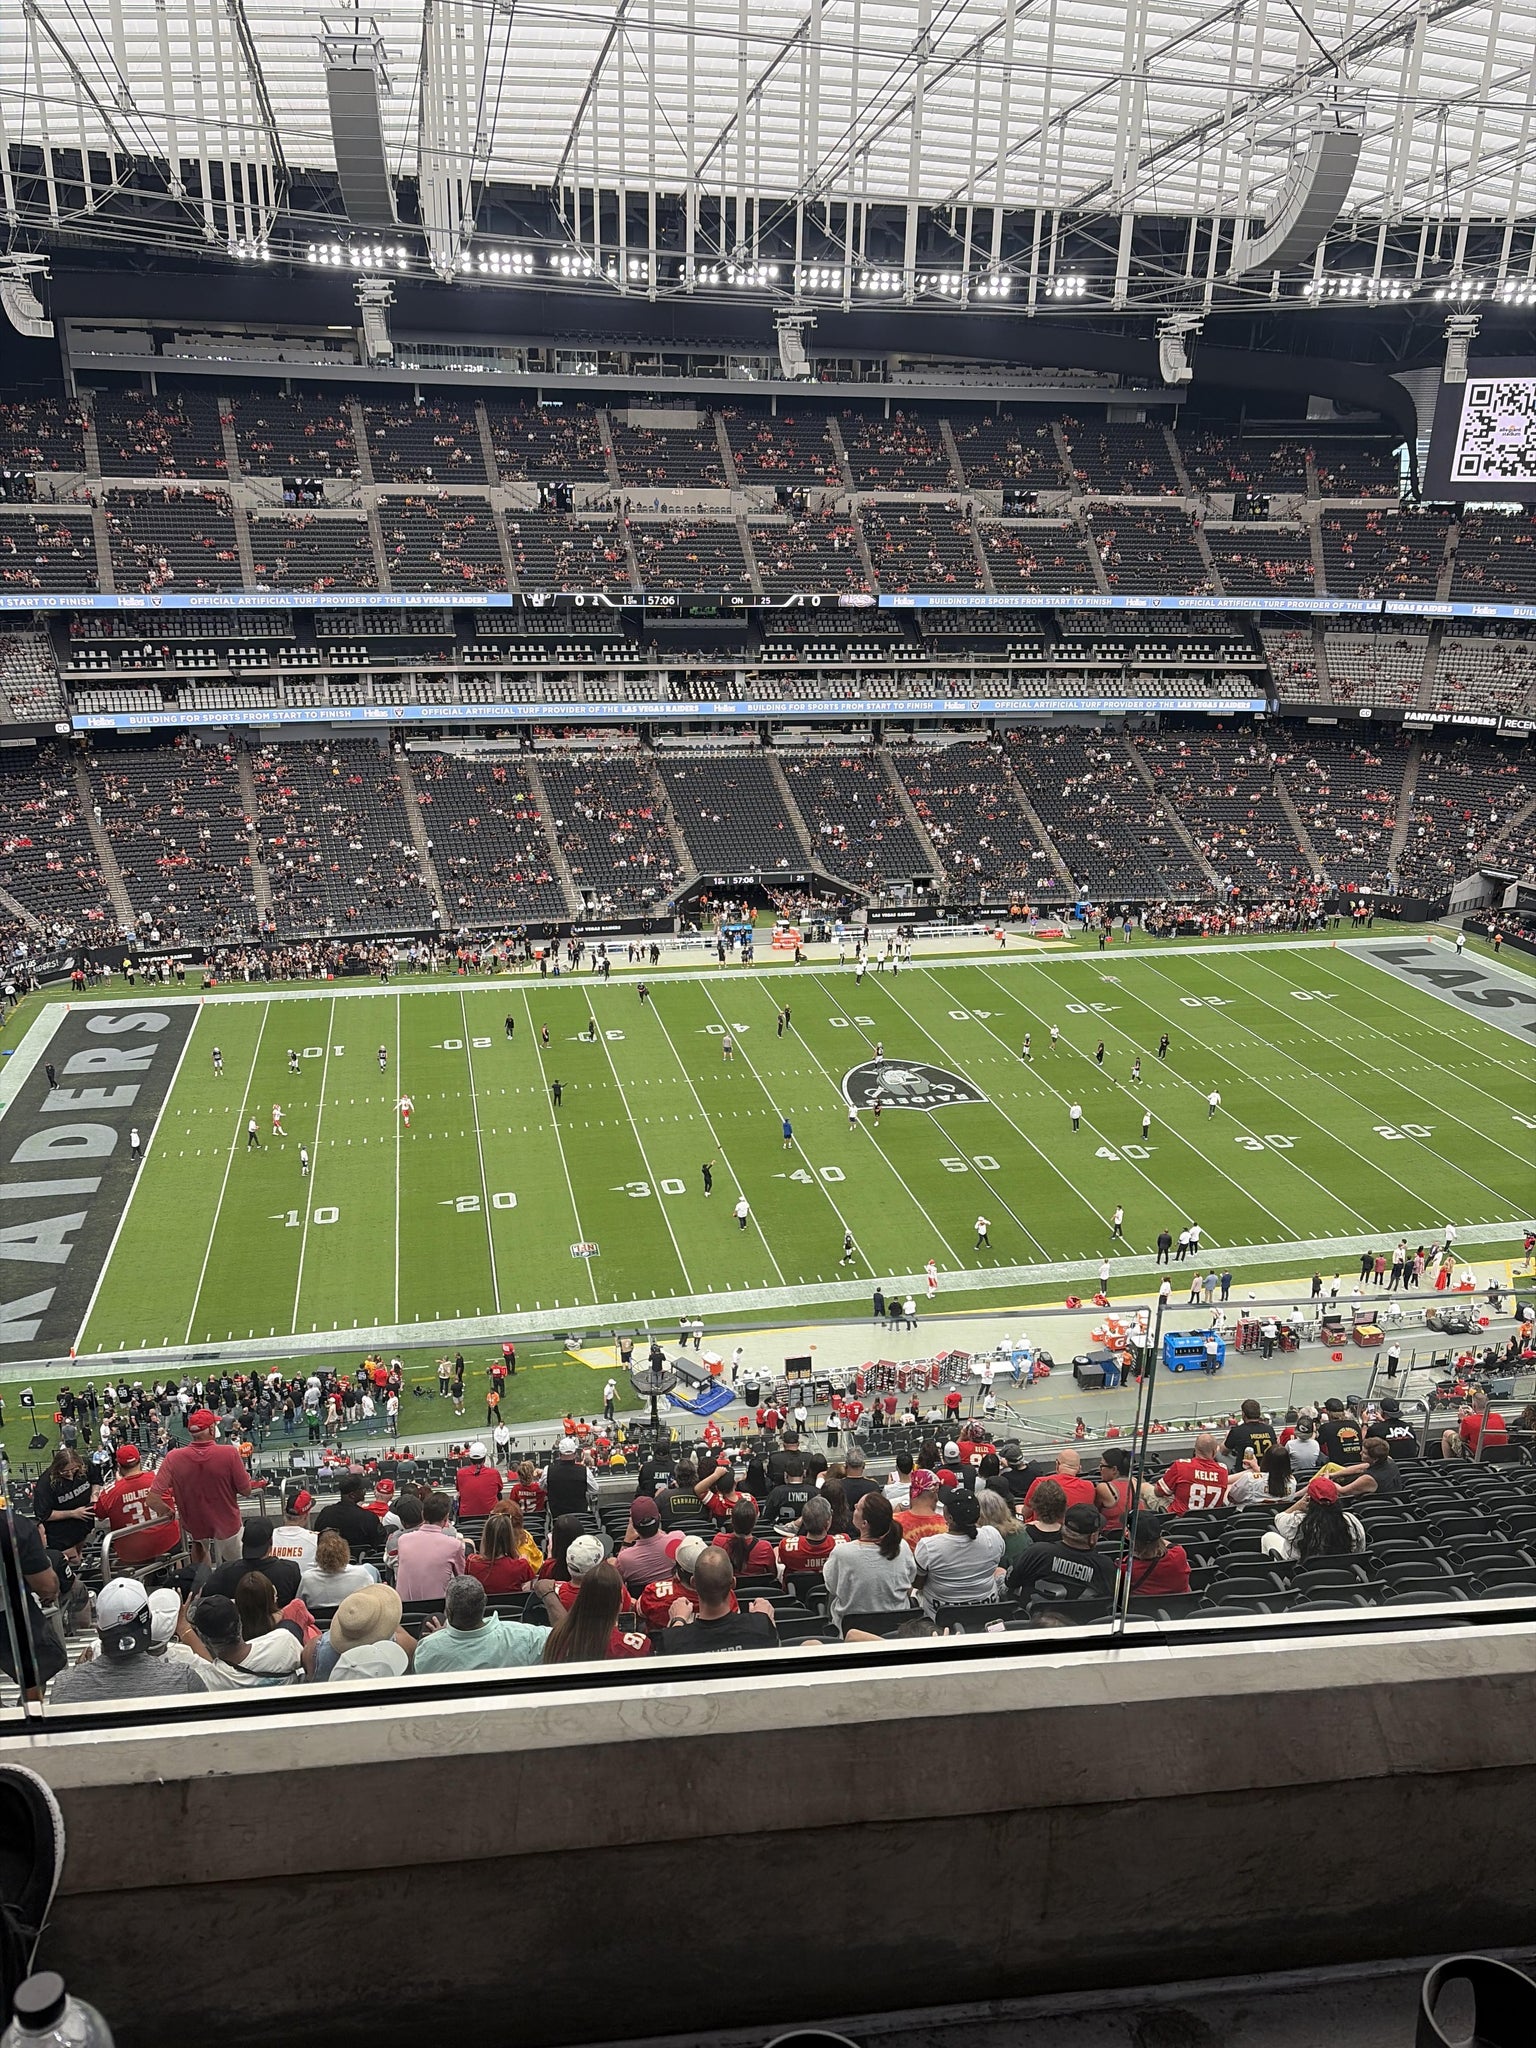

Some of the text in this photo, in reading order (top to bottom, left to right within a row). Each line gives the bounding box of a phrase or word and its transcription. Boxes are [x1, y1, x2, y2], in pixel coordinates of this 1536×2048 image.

[7, 598, 38, 606] START
[41, 598, 56, 606] TO
[60, 597, 94, 606] FINISH
[190, 596, 488, 605] OFFICIAL ARTIFICIAL TURF PROVIDER OF THE LAS VEGAS RAIDERS
[575, 596, 584, 606] 0
[648, 596, 675, 605] 57:06
[812, 596, 820, 606] 0
[130, 715, 177, 724] BUILDING
[203, 714, 240, 722] SPORTS
[272, 711, 302, 720] START
[466, 707, 515, 715] ARTIFICIAL
[1405, 712, 1496, 726] FANTASY LEADERS
[31, 960, 59, 972] AIDERS!
[1368, 948, 1536, 1008] LAS
[1372, 1124, 1434, 1140] 20
[1234, 1134, 1294, 1152] 30
[1095, 1144, 1151, 1162] 40
[939, 1155, 1000, 1172] 50
[787, 1166, 846, 1184] 40
[626, 1178, 686, 1198] 30
[454, 1192, 518, 1212] 20
[285, 1207, 340, 1227] 10
[1115, 1338, 1124, 1347] G
[1386, 1426, 1414, 1439] JAX
[1254, 1440, 1272, 1457] 12
[970, 1454, 986, 1466] 8
[1195, 1469, 1219, 1482] KELCE
[58, 1481, 91, 1503] RAIDERS
[788, 1492, 808, 1502] LYNCH
[1188, 1484, 1222, 1510] 87
[269, 1547, 303, 1557] MAHOMES
[805, 1558, 828, 1567] JONE
[1052, 1556, 1094, 1582] WOODSON
[65, 1565, 71, 1578] 9
